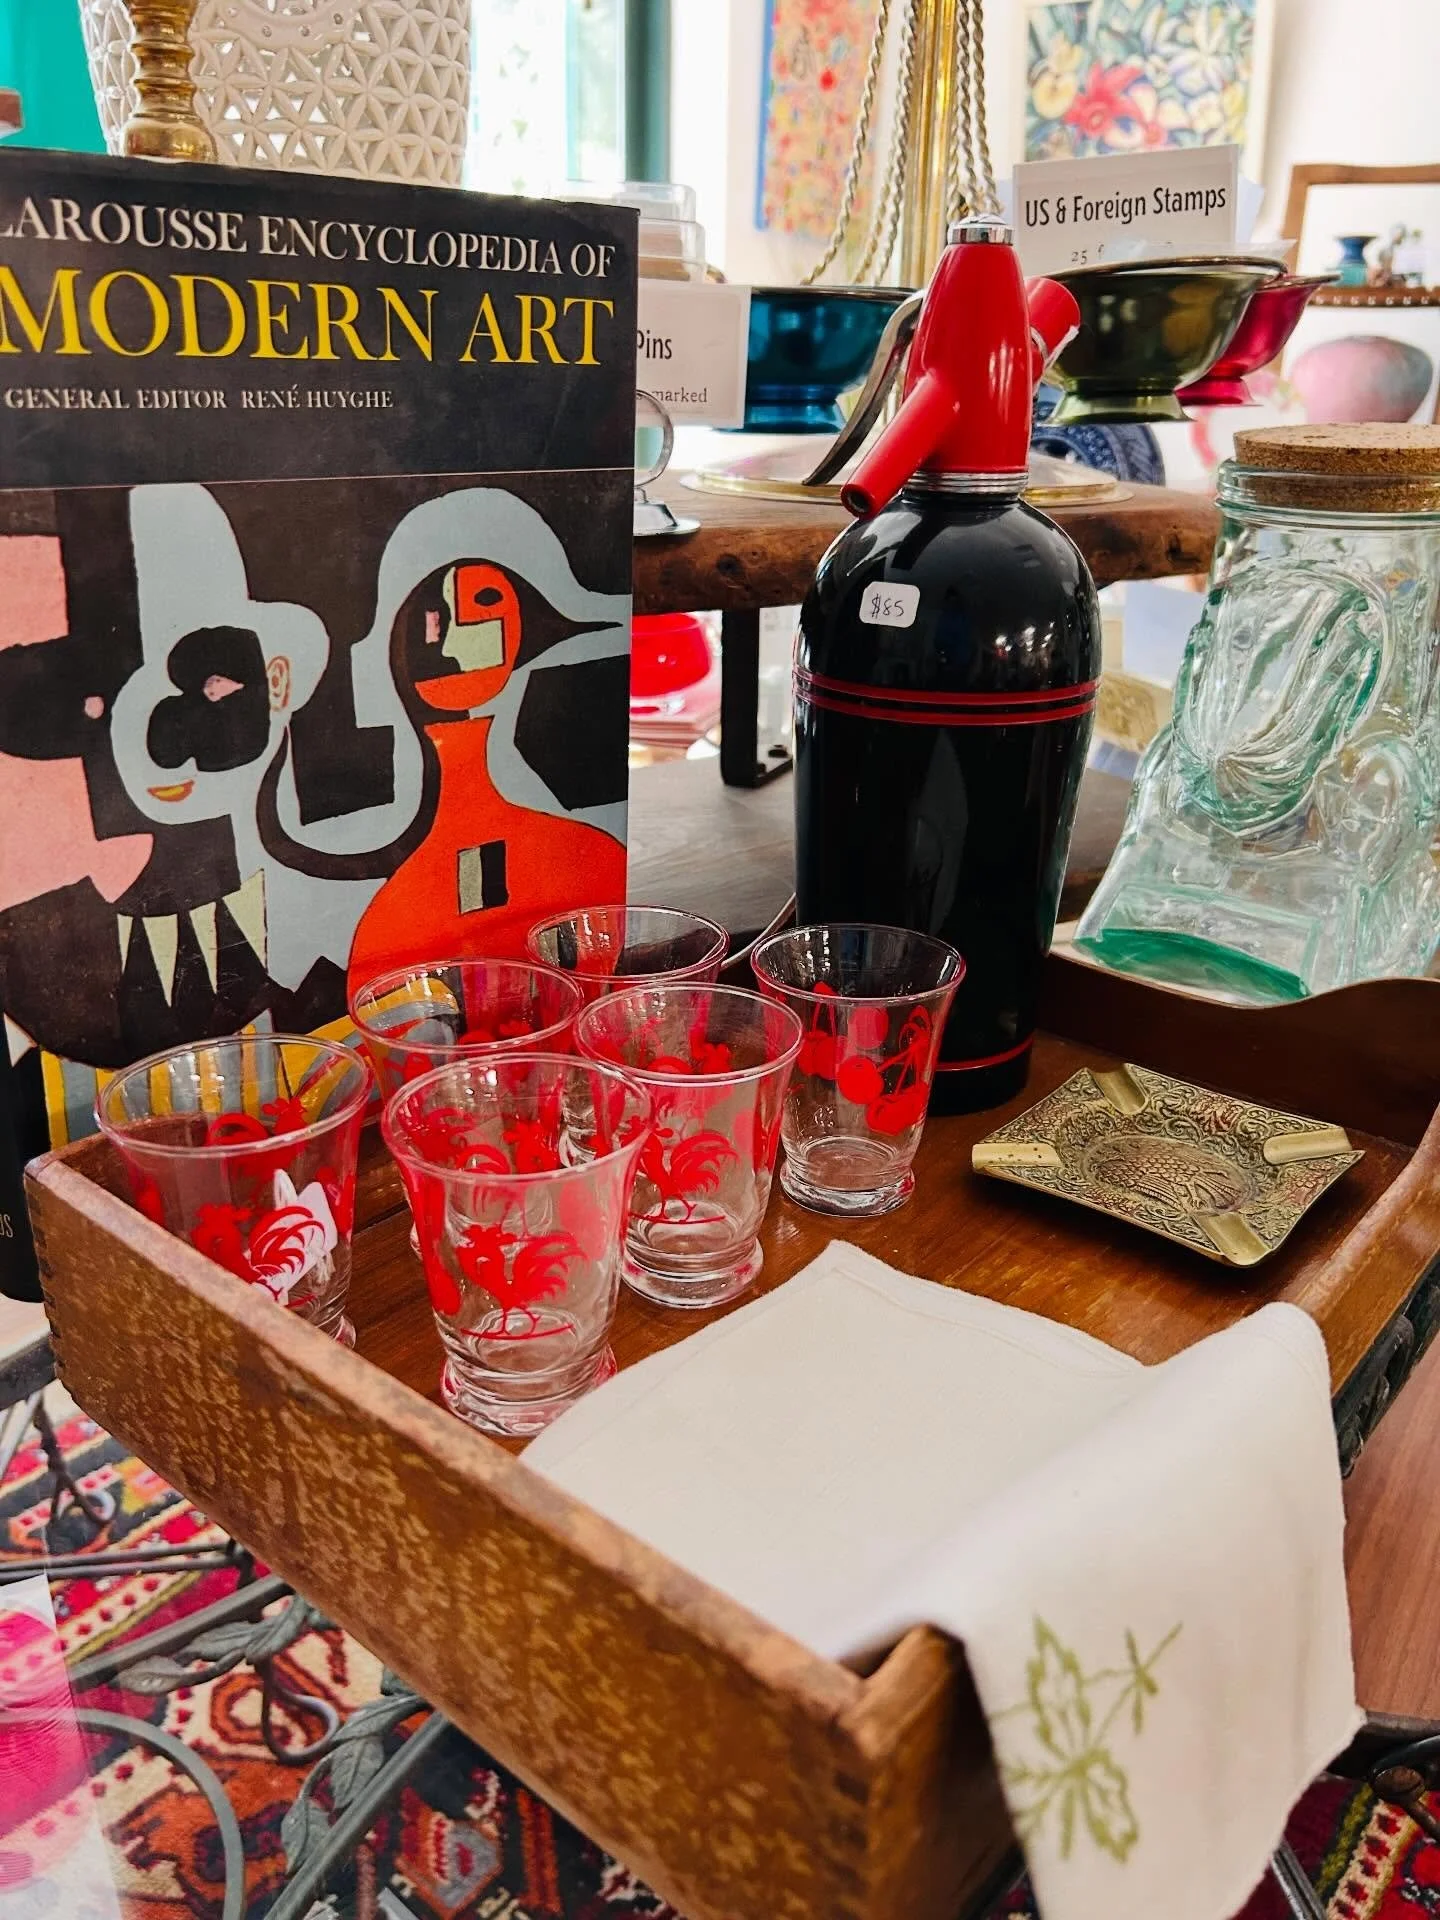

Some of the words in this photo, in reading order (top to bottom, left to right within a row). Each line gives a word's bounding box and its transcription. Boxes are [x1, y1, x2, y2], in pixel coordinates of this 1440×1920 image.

[1025, 198, 1050, 227] US
[1056, 197, 1067, 224] &
[1073, 191, 1146, 225] Foreign
[1152, 187, 1226, 216] Stamps
[259, 213, 564, 275] ENCYCLOPEDIA
[570, 243, 616, 278] OF
[0, 265, 439, 362] MODERN
[458, 293, 614, 365] ART
[4, 388, 130, 409] GENERAL
[137, 389, 227, 409] EDITOR
[242, 384, 301, 409] RENÉ
[307, 390, 394, 408] HUYGHE
[871, 593, 905, 619] $85
